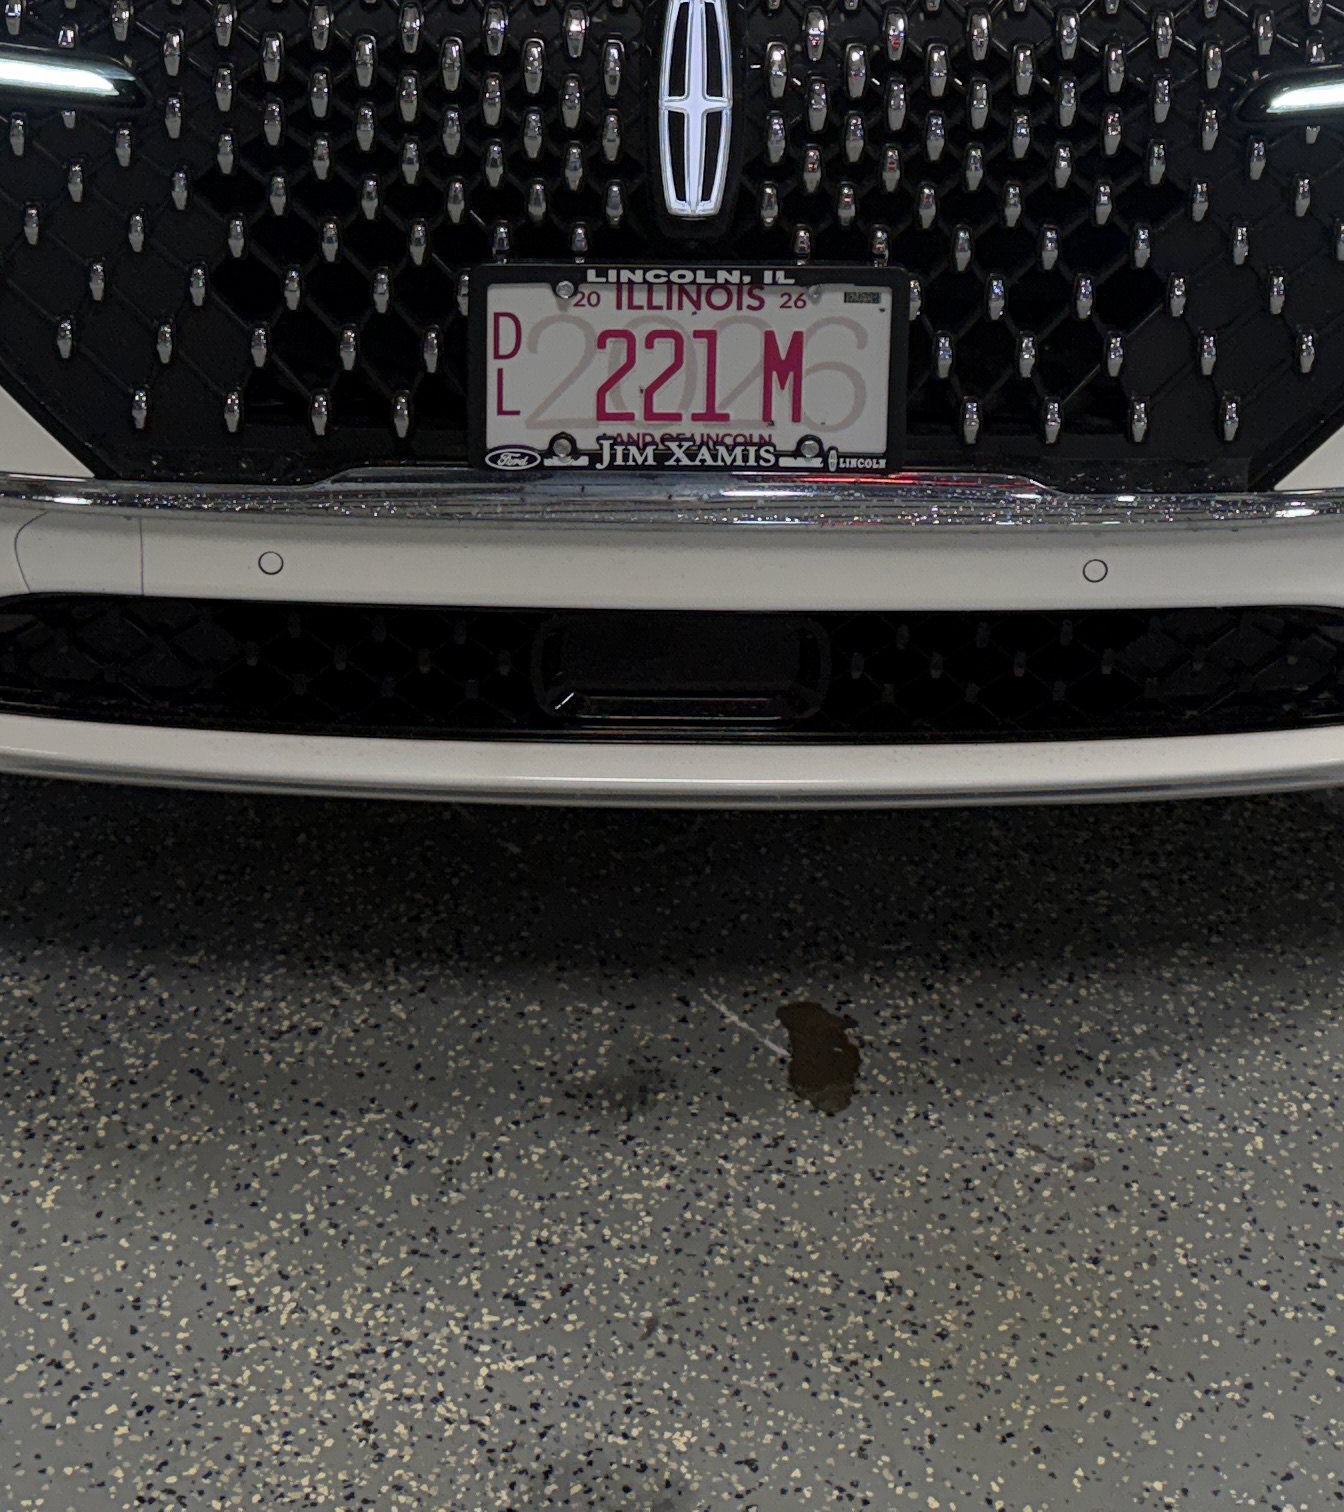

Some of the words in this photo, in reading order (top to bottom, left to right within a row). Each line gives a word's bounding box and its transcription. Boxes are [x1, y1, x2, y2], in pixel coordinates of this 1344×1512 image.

[586, 269, 751, 285] LINCOLN,
[763, 270, 795, 285] IL
[573, 290, 601, 308] 20
[615, 284, 766, 311] ILLINOIS
[779, 291, 806, 309] 26
[596, 329, 730, 422] 221
[762, 330, 804, 423] M
[600, 432, 656, 445] AND
[497, 452, 529, 467] Ford
[596, 440, 657, 470] JIM
[664, 441, 776, 467] XAMIS
[839, 458, 887, 469] LINCOLN
